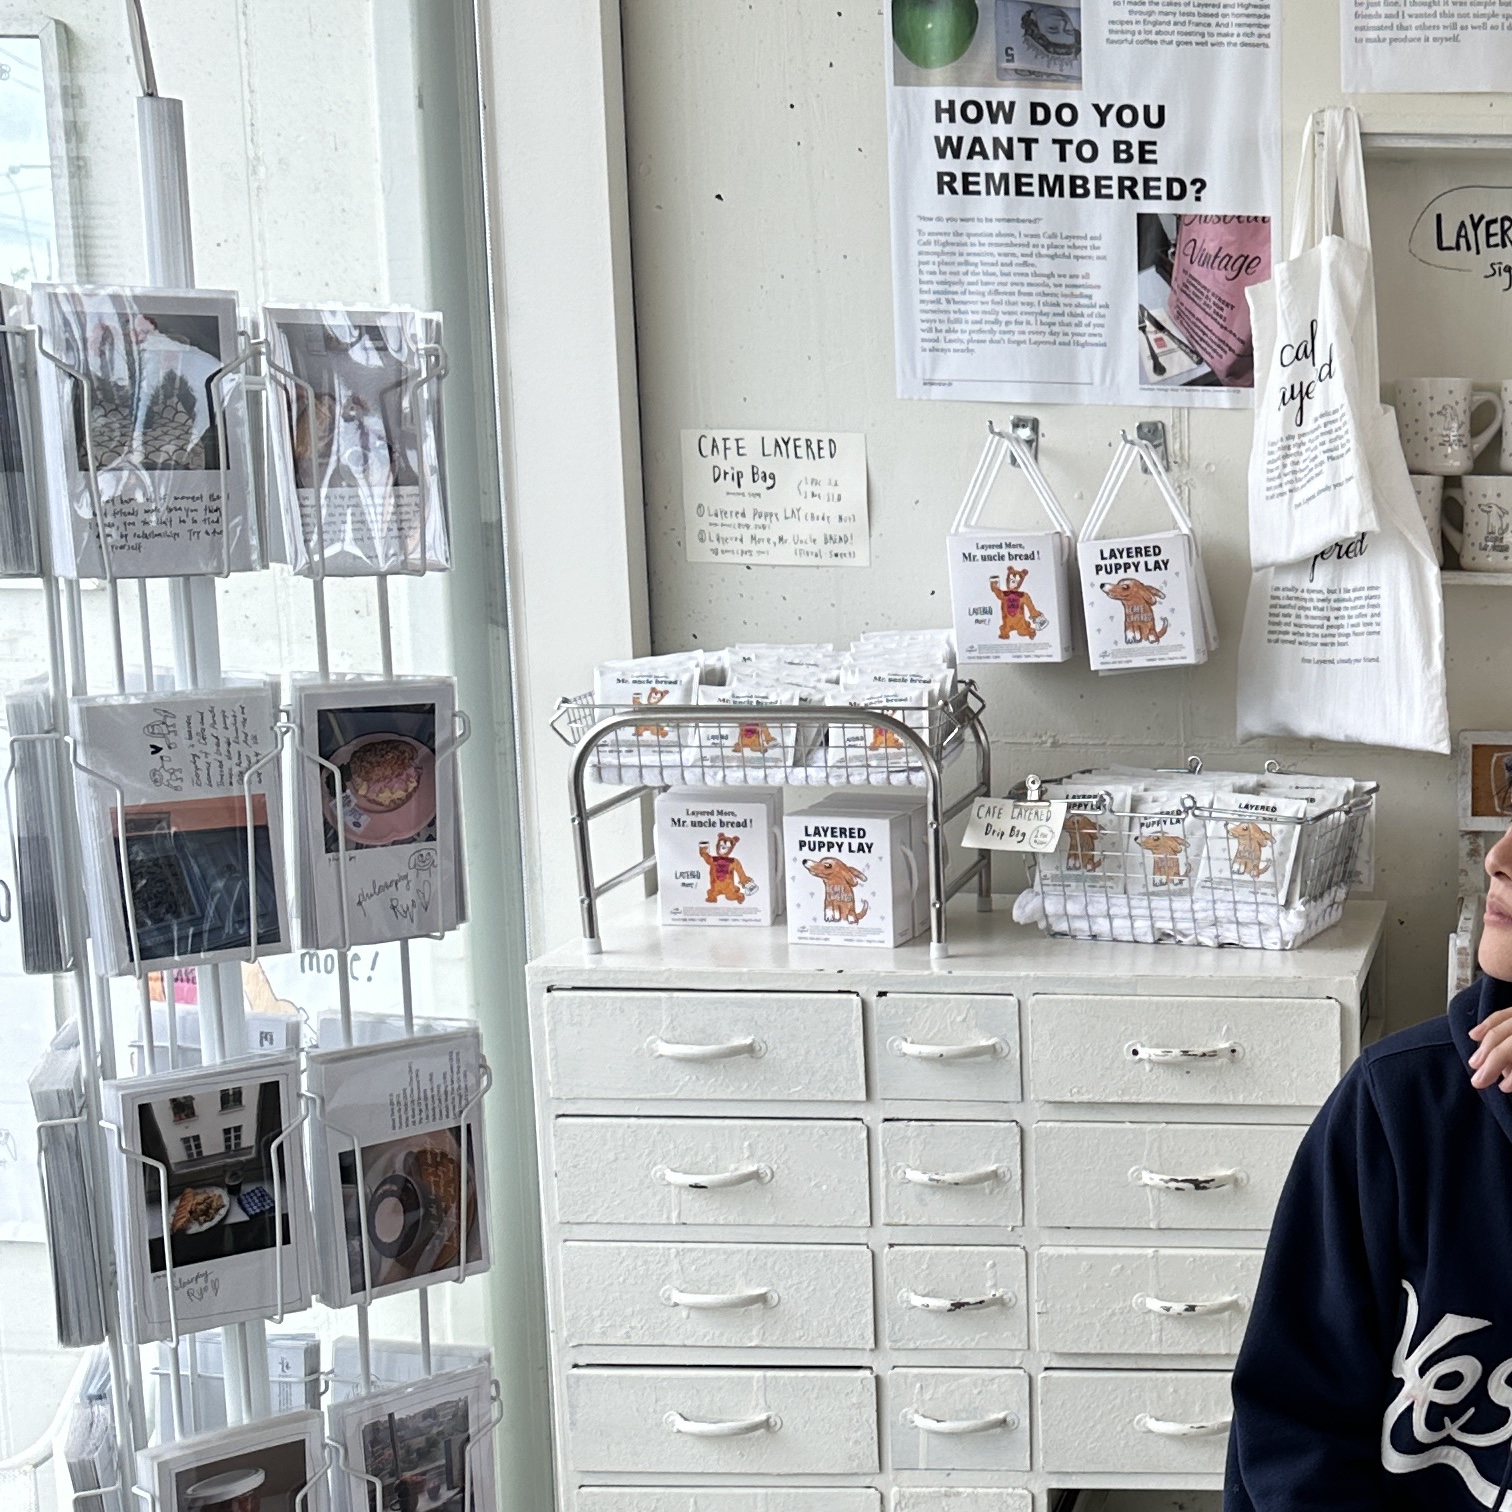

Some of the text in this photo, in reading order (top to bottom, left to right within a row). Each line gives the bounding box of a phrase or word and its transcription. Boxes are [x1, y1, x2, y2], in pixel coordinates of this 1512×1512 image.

[1108, 19, 1133, 27] recipes
[1143, 19, 1171, 28] England
[1231, 12, 1271, 20] homemade
[1355, 12, 1382, 20] friends
[1408, 12, 1437, 20] wanted
[1440, 11, 1455, 19] this
[1473, 12, 1499, 21] simple
[1108, 28, 1135, 36] thinking
[1396, 23, 1413, 31] that
[1415, 23, 1440, 31] others
[1442, 23, 1457, 31] will
[1471, 23, 1487, 31] well
[1106, 38, 1134, 46] flavorful
[1135, 38, 1158, 46] coffee
[1160, 38, 1174, 46] that
[934, 99, 1166, 129] HOW DO YOU
[934, 135, 1158, 165] WANT TO BE
[936, 171, 1207, 202] REMEMBERED?
[1182, 238, 1262, 281] Vintage
[698, 434, 837, 461] CAFE LAYERED
[712, 465, 776, 490] Drip Bag
[707, 507, 746, 519] Layered
[784, 506, 802, 521] LAY
[975, 541, 1026, 551] Layered More,
[1100, 545, 1162, 561] LAYERED
[962, 552, 980, 563] Mr.
[981, 552, 1006, 562] uncle
[1095, 558, 1170, 576] PUPPY LAY
[686, 808, 714, 818] Layered
[976, 804, 1052, 823] CAFE LAYERED
[1238, 802, 1277, 813] LAYERED
[671, 818, 688, 828] Mr.
[690, 818, 717, 828] uncle
[804, 825, 867, 839] LAYERED
[984, 822, 1027, 844] Drip Bag
[798, 840, 874, 855] PUPPY LAY
[301, 951, 379, 982] moe!
